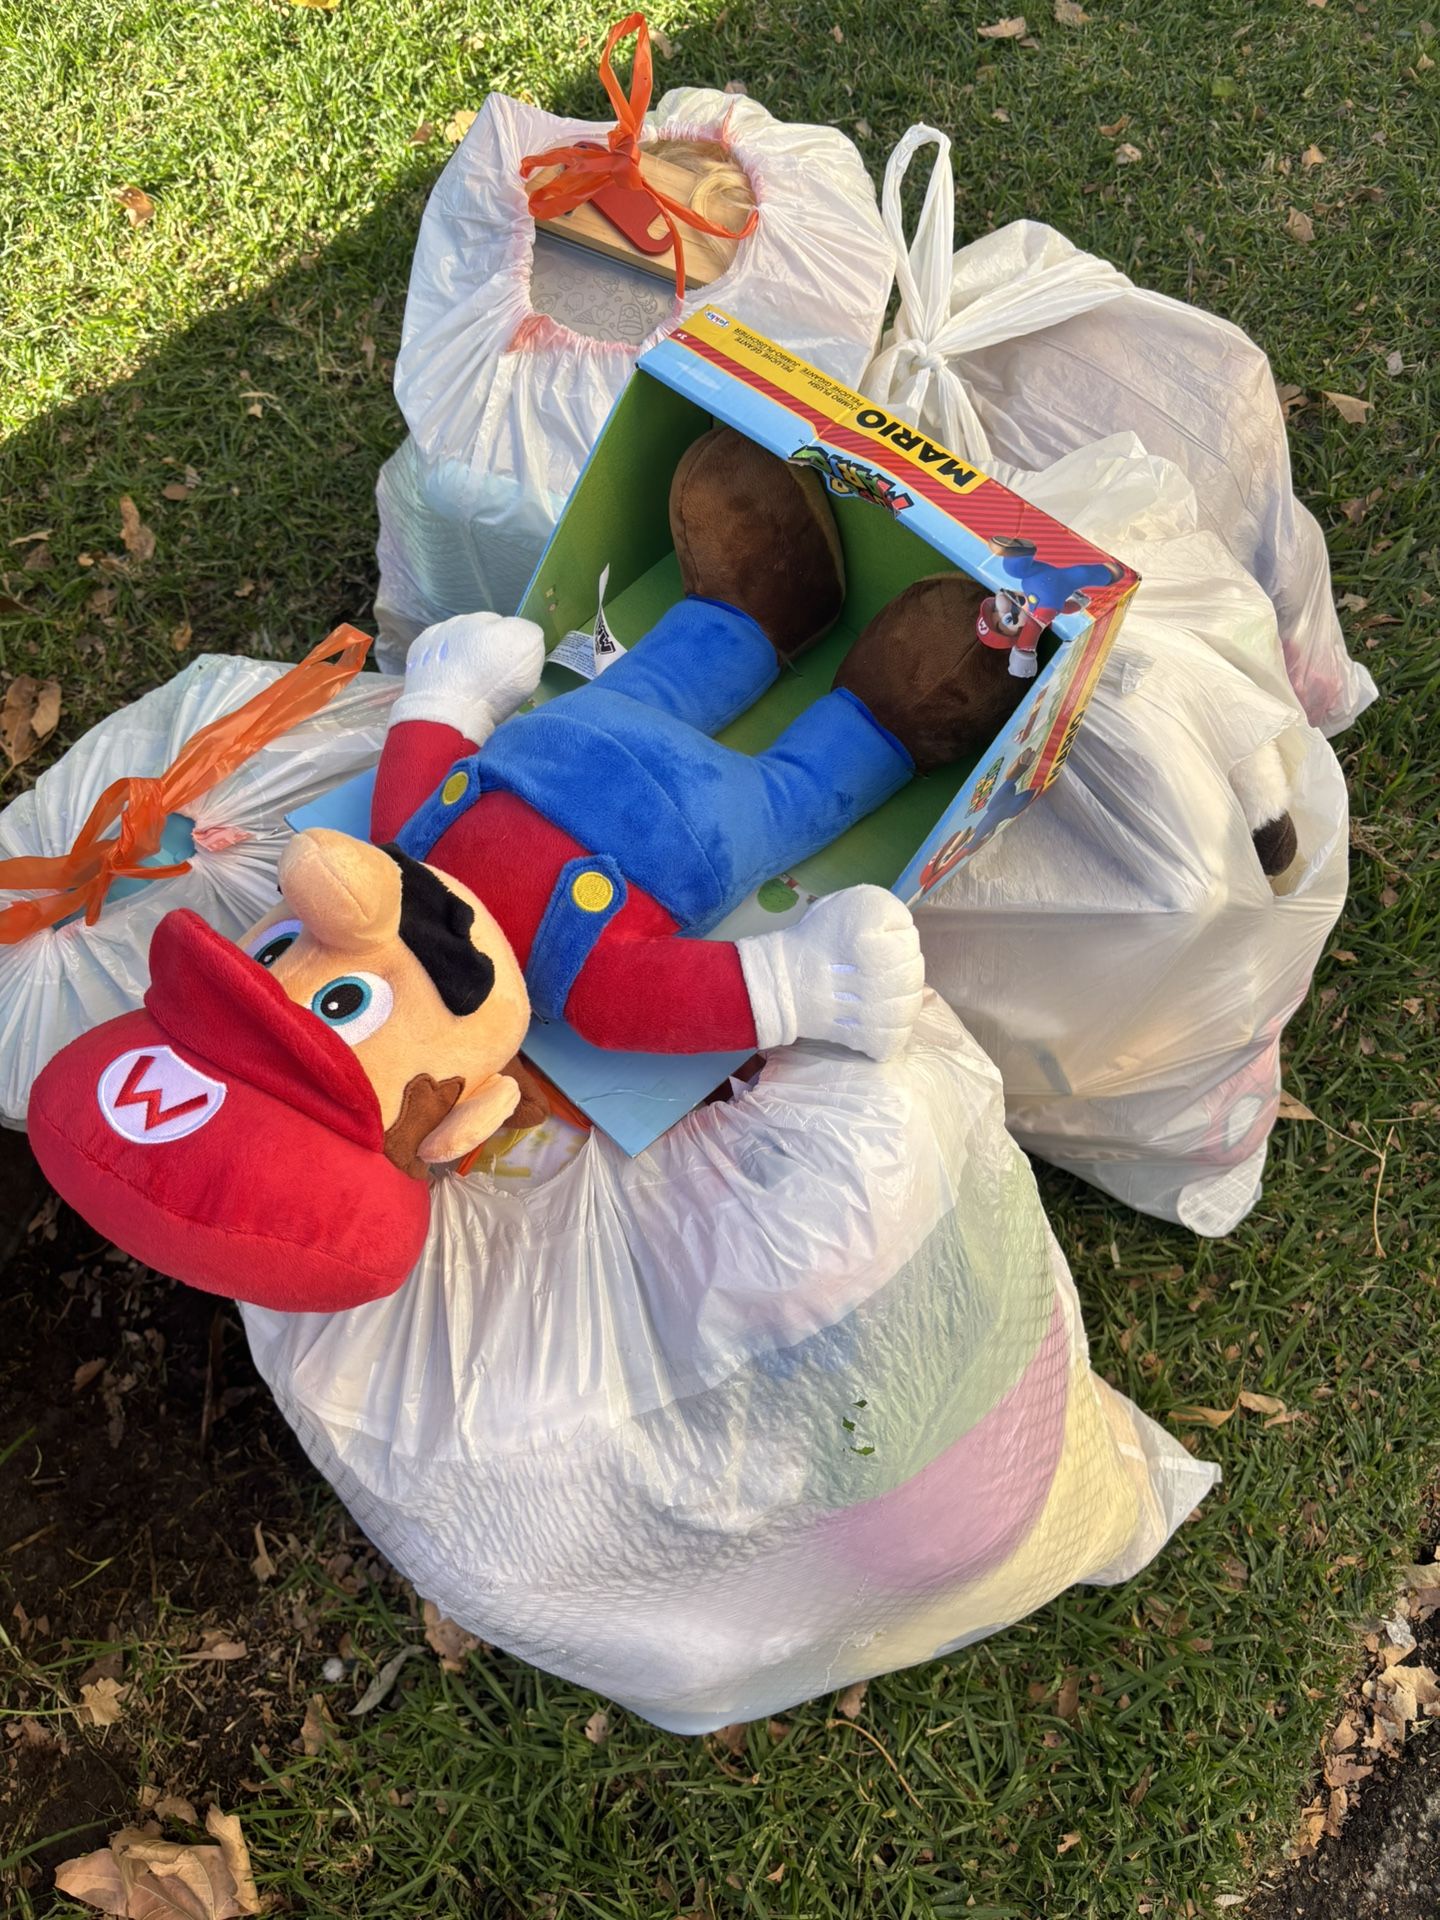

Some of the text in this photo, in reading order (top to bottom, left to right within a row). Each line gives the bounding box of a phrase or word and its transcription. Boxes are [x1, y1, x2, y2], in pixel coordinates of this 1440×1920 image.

[761, 352, 794, 373] PELUCHE
[800, 367, 864, 407] PELUCHE GIGANTE
[807, 380, 858, 411] JUMBO PLUSH
[856, 409, 977, 488] MARIO
[1047, 709, 1085, 784] MARIO
